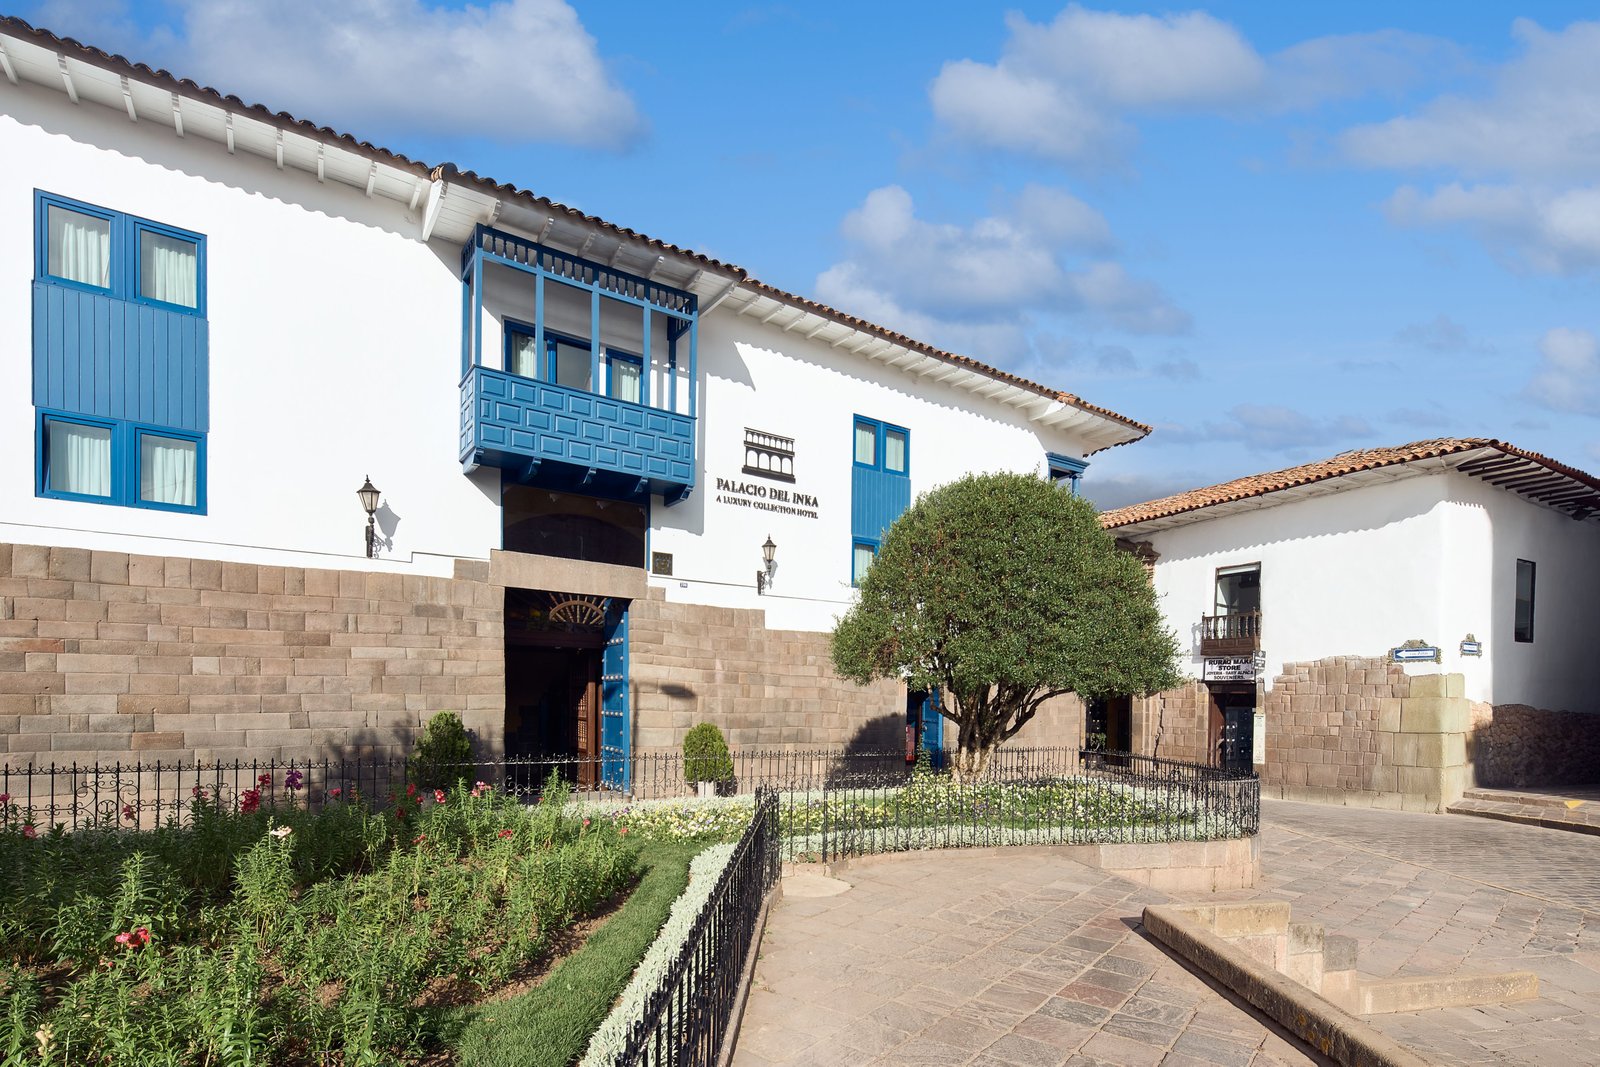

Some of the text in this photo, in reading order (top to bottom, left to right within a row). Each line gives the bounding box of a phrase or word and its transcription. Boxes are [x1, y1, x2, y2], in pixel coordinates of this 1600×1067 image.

[717, 478, 819, 508] PALACIO DEL INKA
[716, 495, 819, 519] A LUXURY COLLECTION HOTEL
